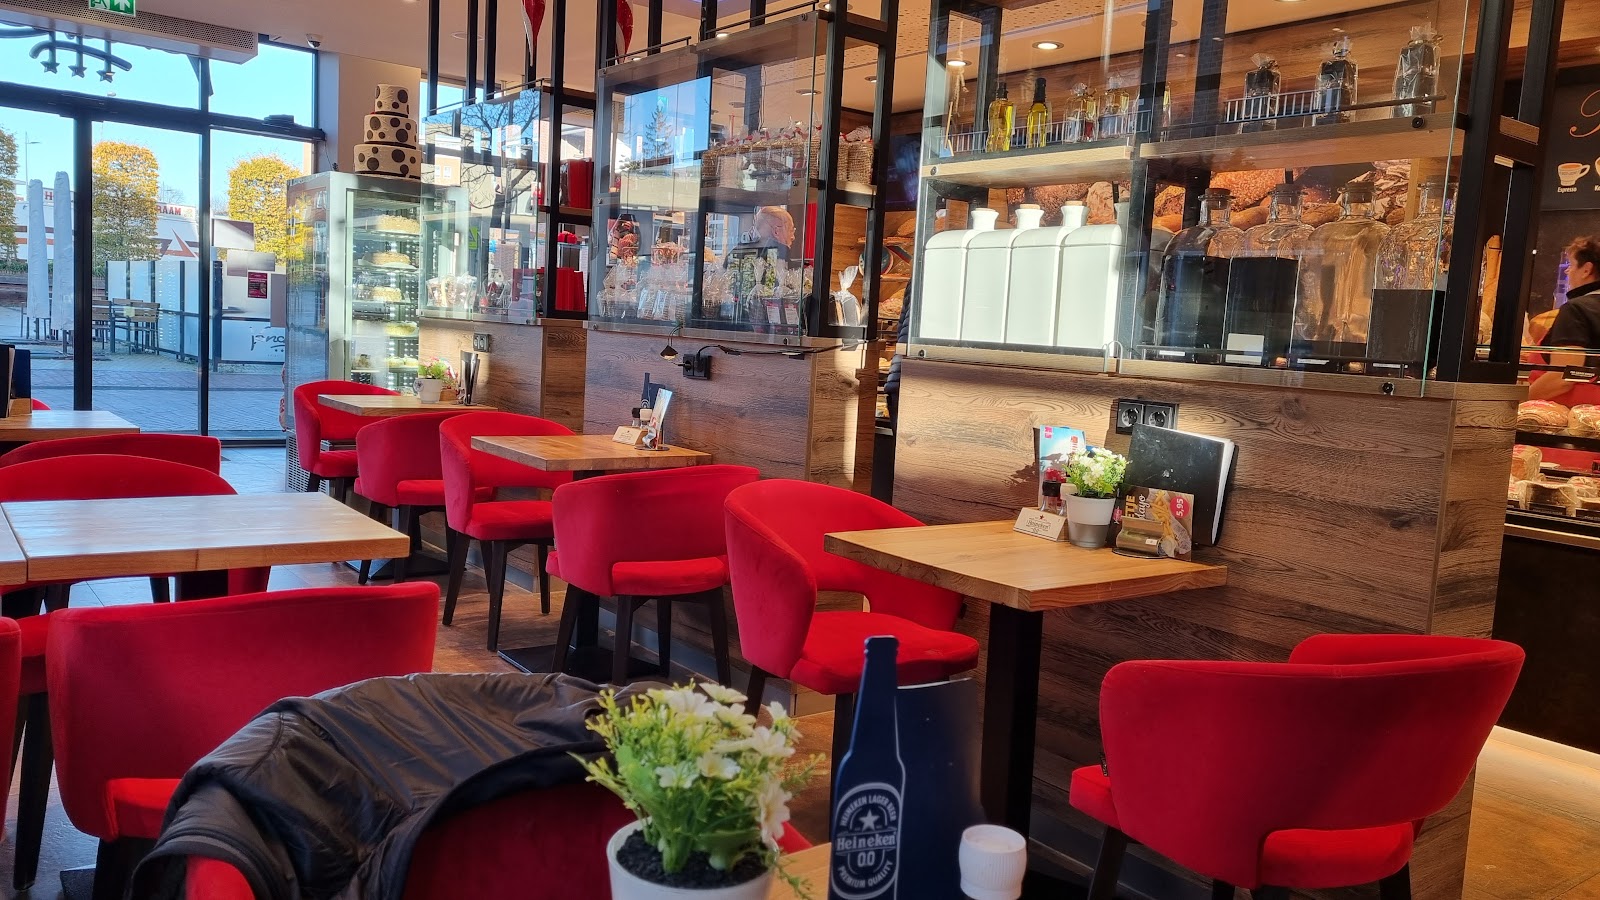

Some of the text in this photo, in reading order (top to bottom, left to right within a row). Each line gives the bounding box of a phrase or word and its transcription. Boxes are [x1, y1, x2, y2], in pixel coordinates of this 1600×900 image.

[1125, 494, 1138, 518] ETJE
[1176, 498, 1184, 517] 5,95
[840, 795, 867, 826] HEINEKEN
[837, 833, 896, 851] Heineken
[838, 859, 893, 888] PREMIUM QUALITY
